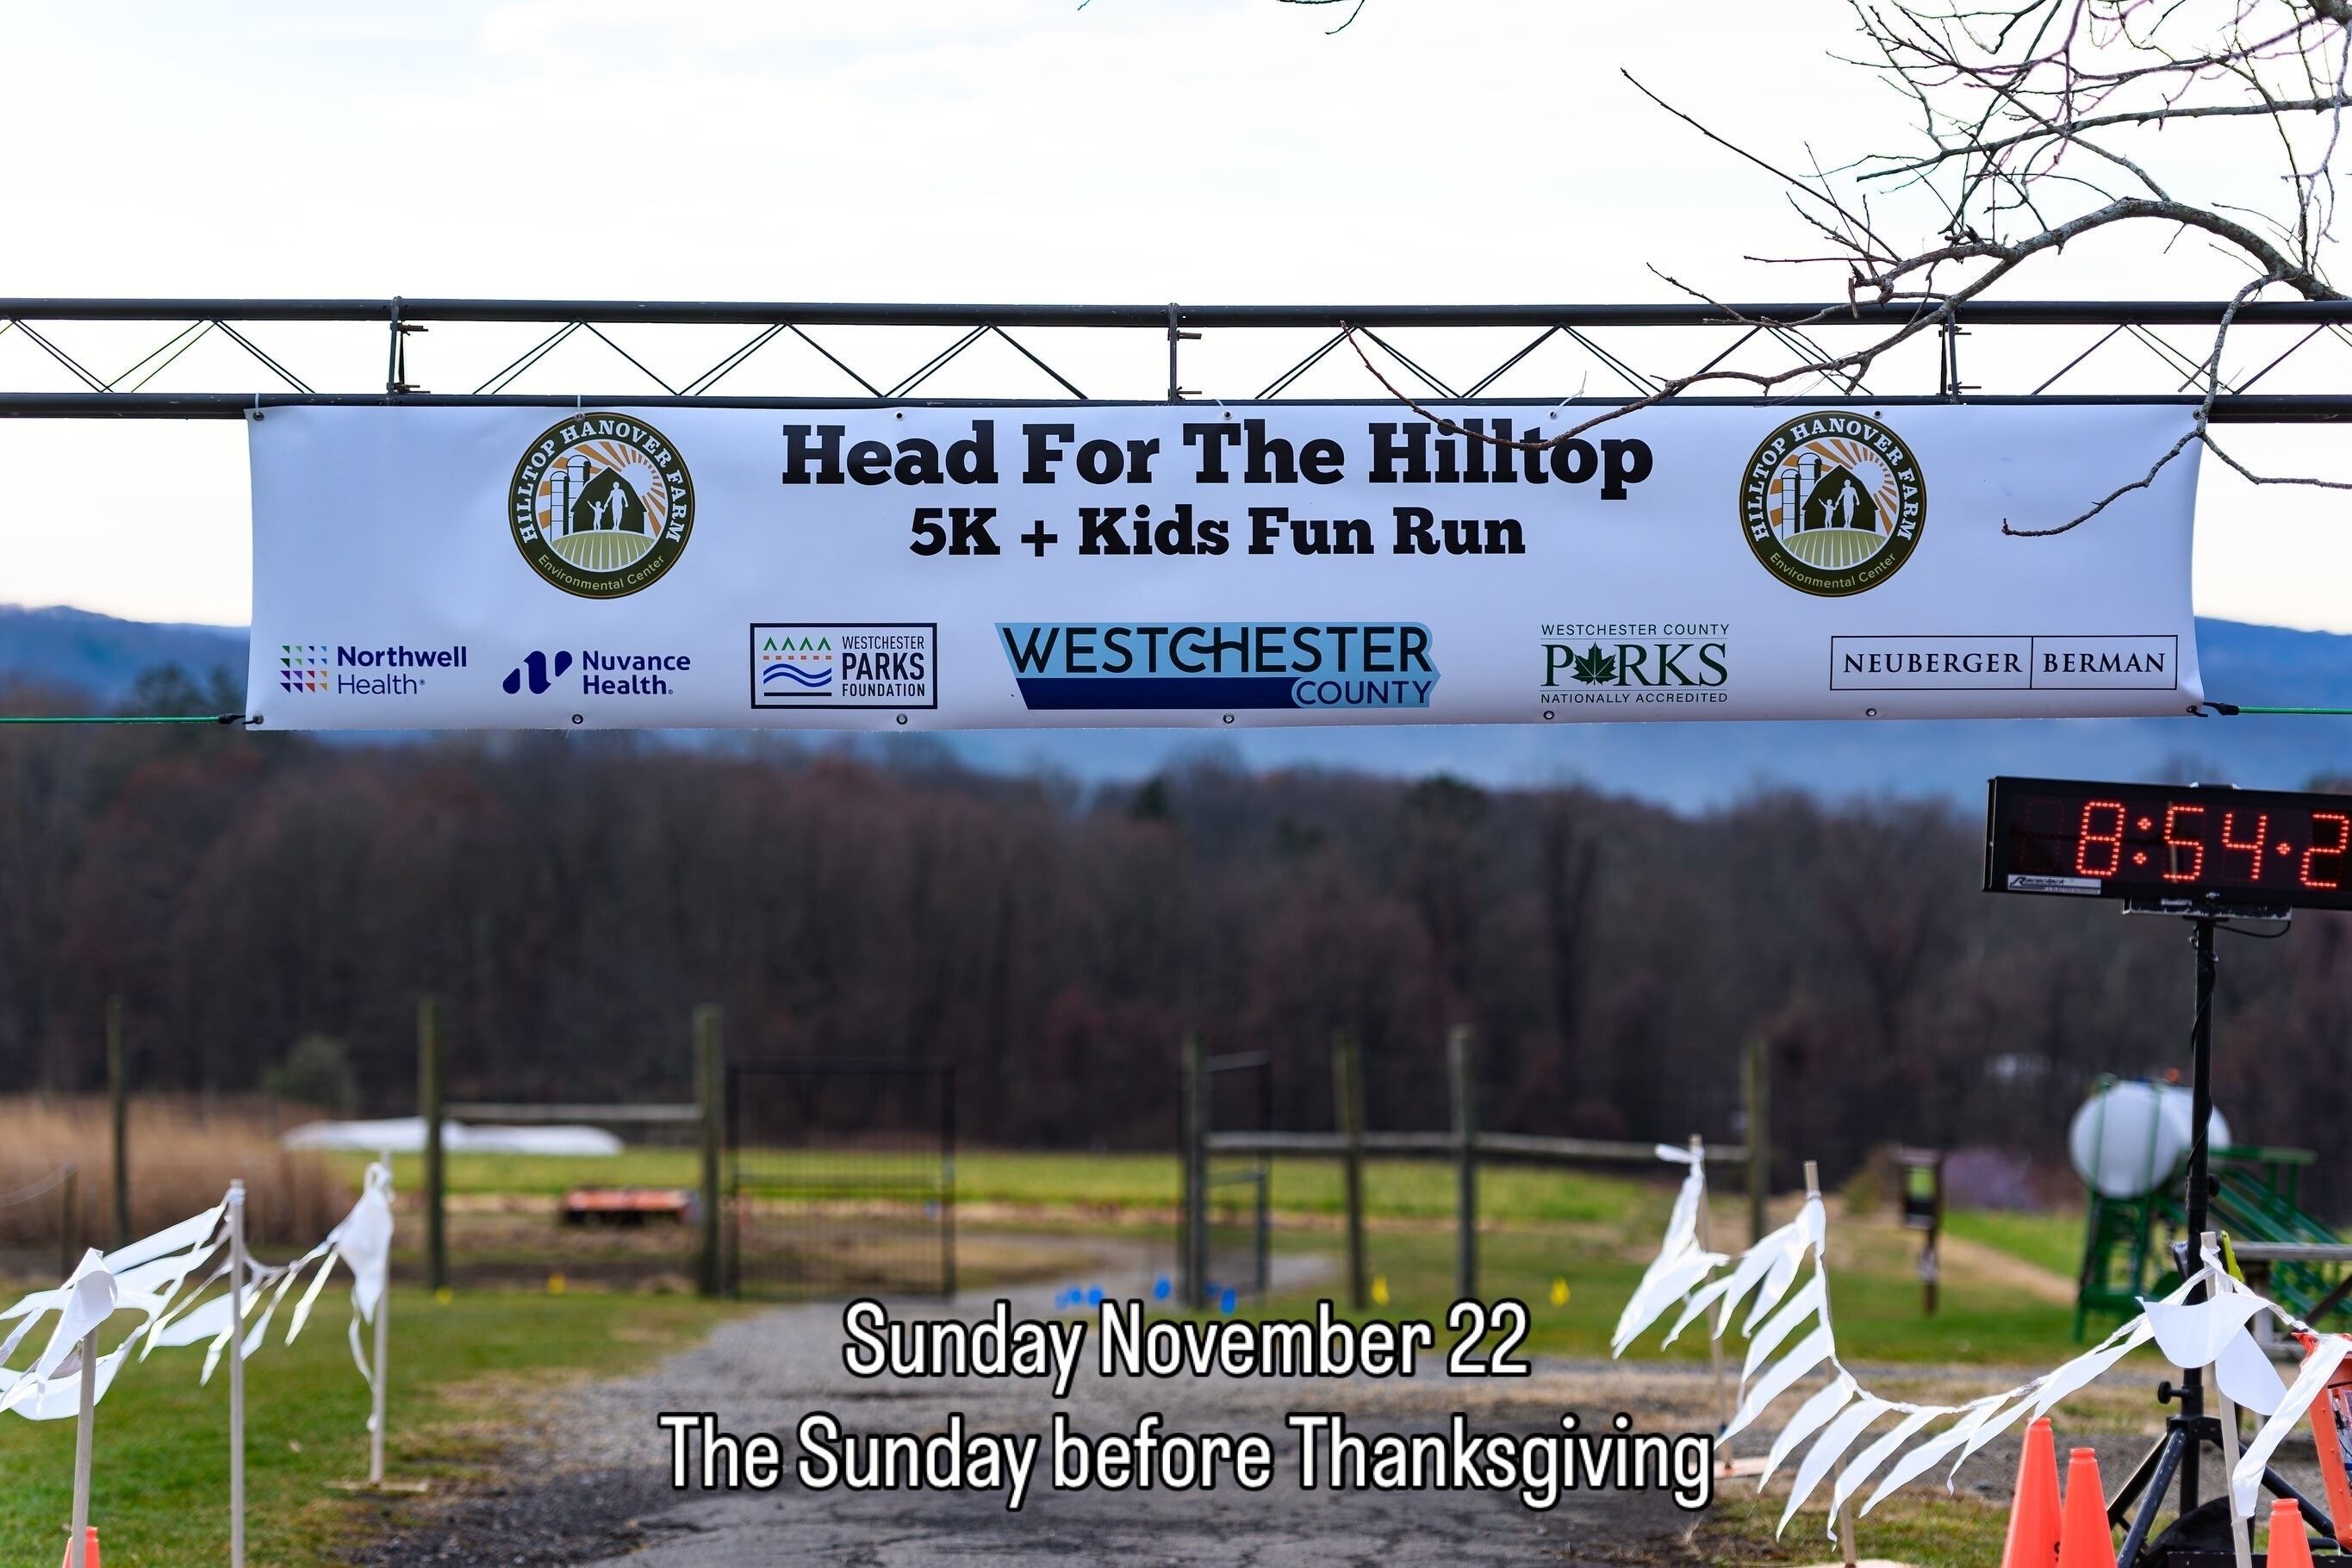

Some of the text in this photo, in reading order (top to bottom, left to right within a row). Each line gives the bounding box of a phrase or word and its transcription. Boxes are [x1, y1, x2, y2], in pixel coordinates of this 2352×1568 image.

[781, 418, 1653, 501] Head For The Hilltop
[516, 420, 688, 544] HILLTOP HANOVER FARM
[1747, 418, 1920, 542] HILLTOP HANOVER FARM
[909, 503, 1526, 557] 5K + Kids Fun Run
[538, 554, 665, 591] Environmental Center
[1770, 552, 1896, 589] Environmental Center
[842, 635, 924, 650] WESTCHESTER
[1541, 624, 1730, 636] WESTCHESTER COUNTY
[337, 645, 467, 668] Northwell
[582, 650, 691, 671] Nuvance
[1002, 626, 1429, 674] WESTCHESTER
[1843, 652, 2166, 673] NEUBERGER BERMAN
[842, 651, 924, 681] PARKS
[842, 683, 925, 697] FOUNDATION
[1294, 679, 1433, 706] COUNTY
[1540, 693, 1728, 704] NATIONALLY ACCREDITED
